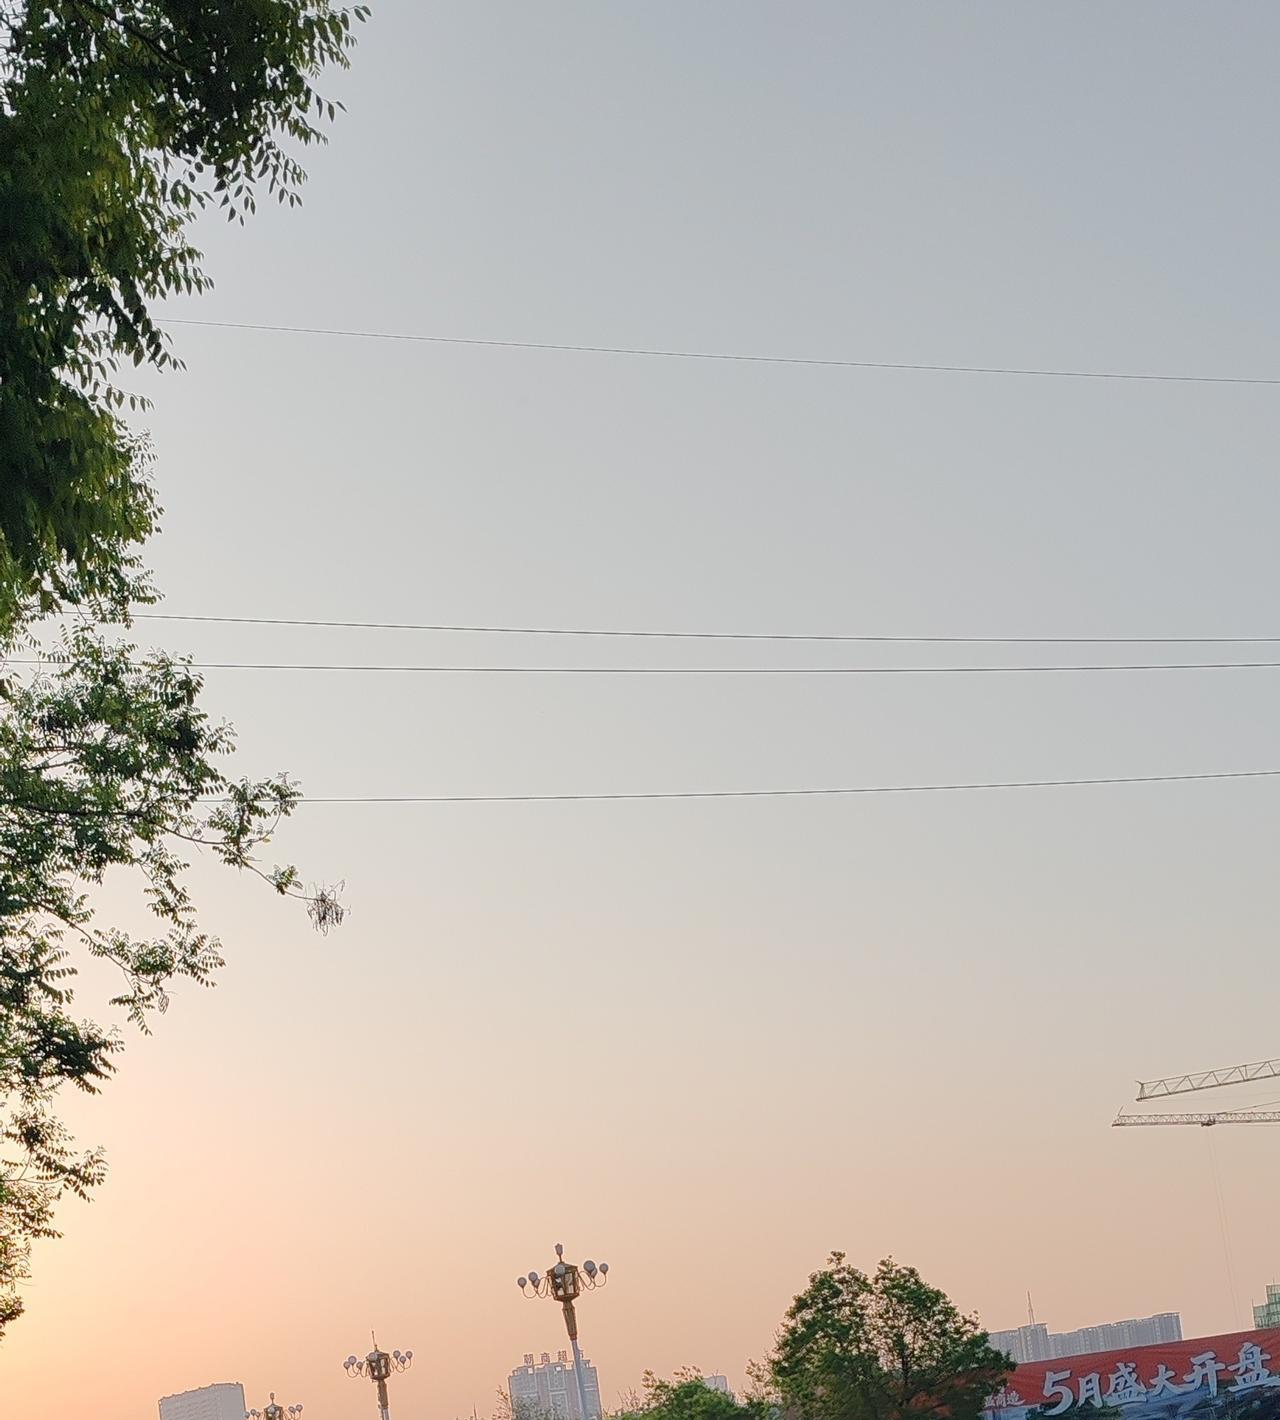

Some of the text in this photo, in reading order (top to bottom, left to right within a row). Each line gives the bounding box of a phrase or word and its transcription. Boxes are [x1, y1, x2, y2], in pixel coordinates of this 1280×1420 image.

[1042, 1341, 1280, 1416] 5月盛大开盘
